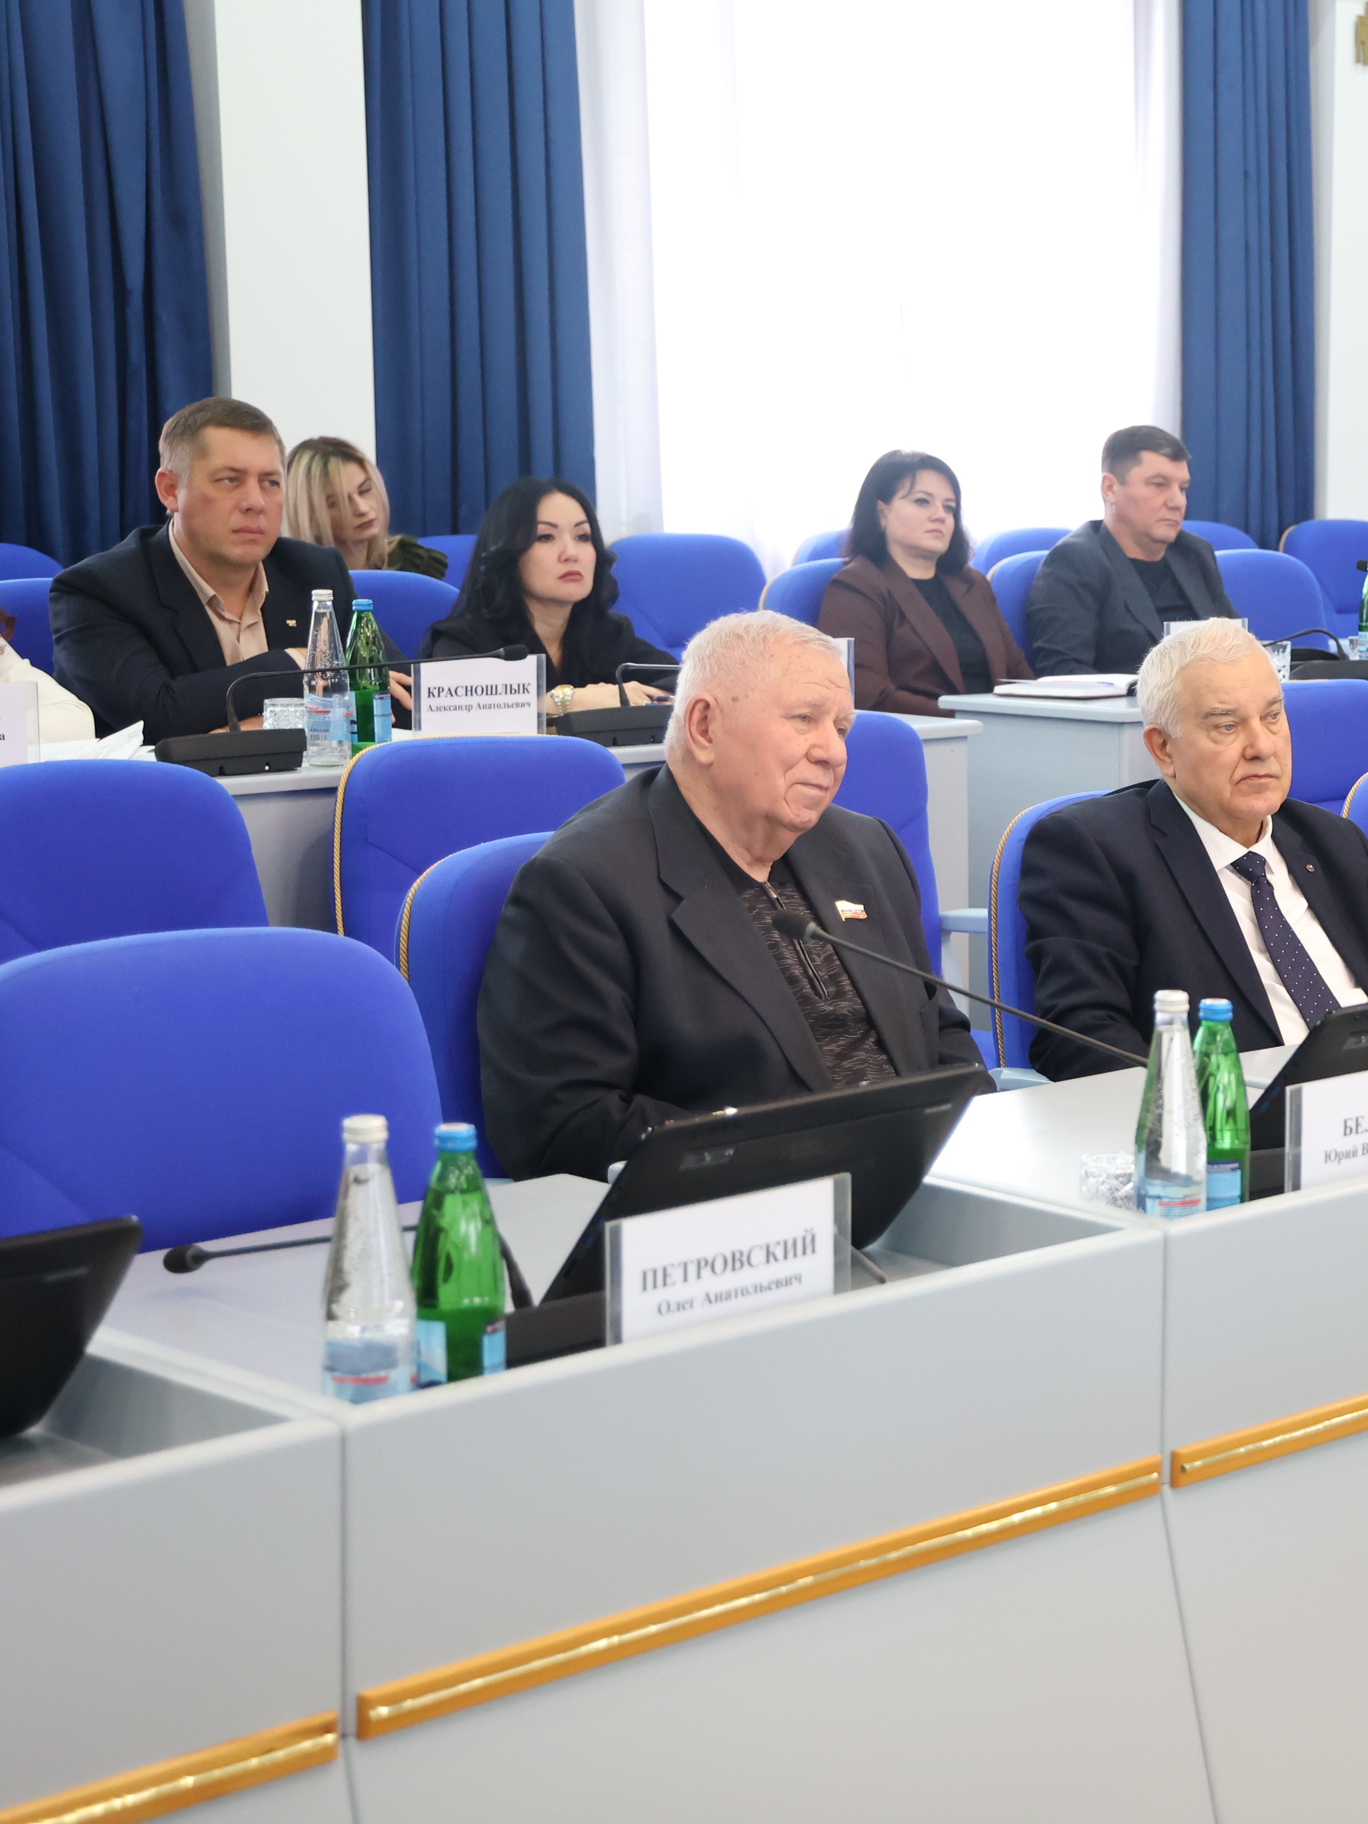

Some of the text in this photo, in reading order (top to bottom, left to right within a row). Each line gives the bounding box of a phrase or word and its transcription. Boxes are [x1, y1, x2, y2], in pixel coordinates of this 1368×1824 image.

[427, 683, 531, 698] КРАСНОШЛЫК
[427, 701, 531, 713] Александр Анатольевич
[1324, 1145, 1358, 1165] Юрий
[641, 1227, 817, 1292] ПЕТРОВСКИЙ
[657, 1273, 803, 1316] Олег Анатольевич
